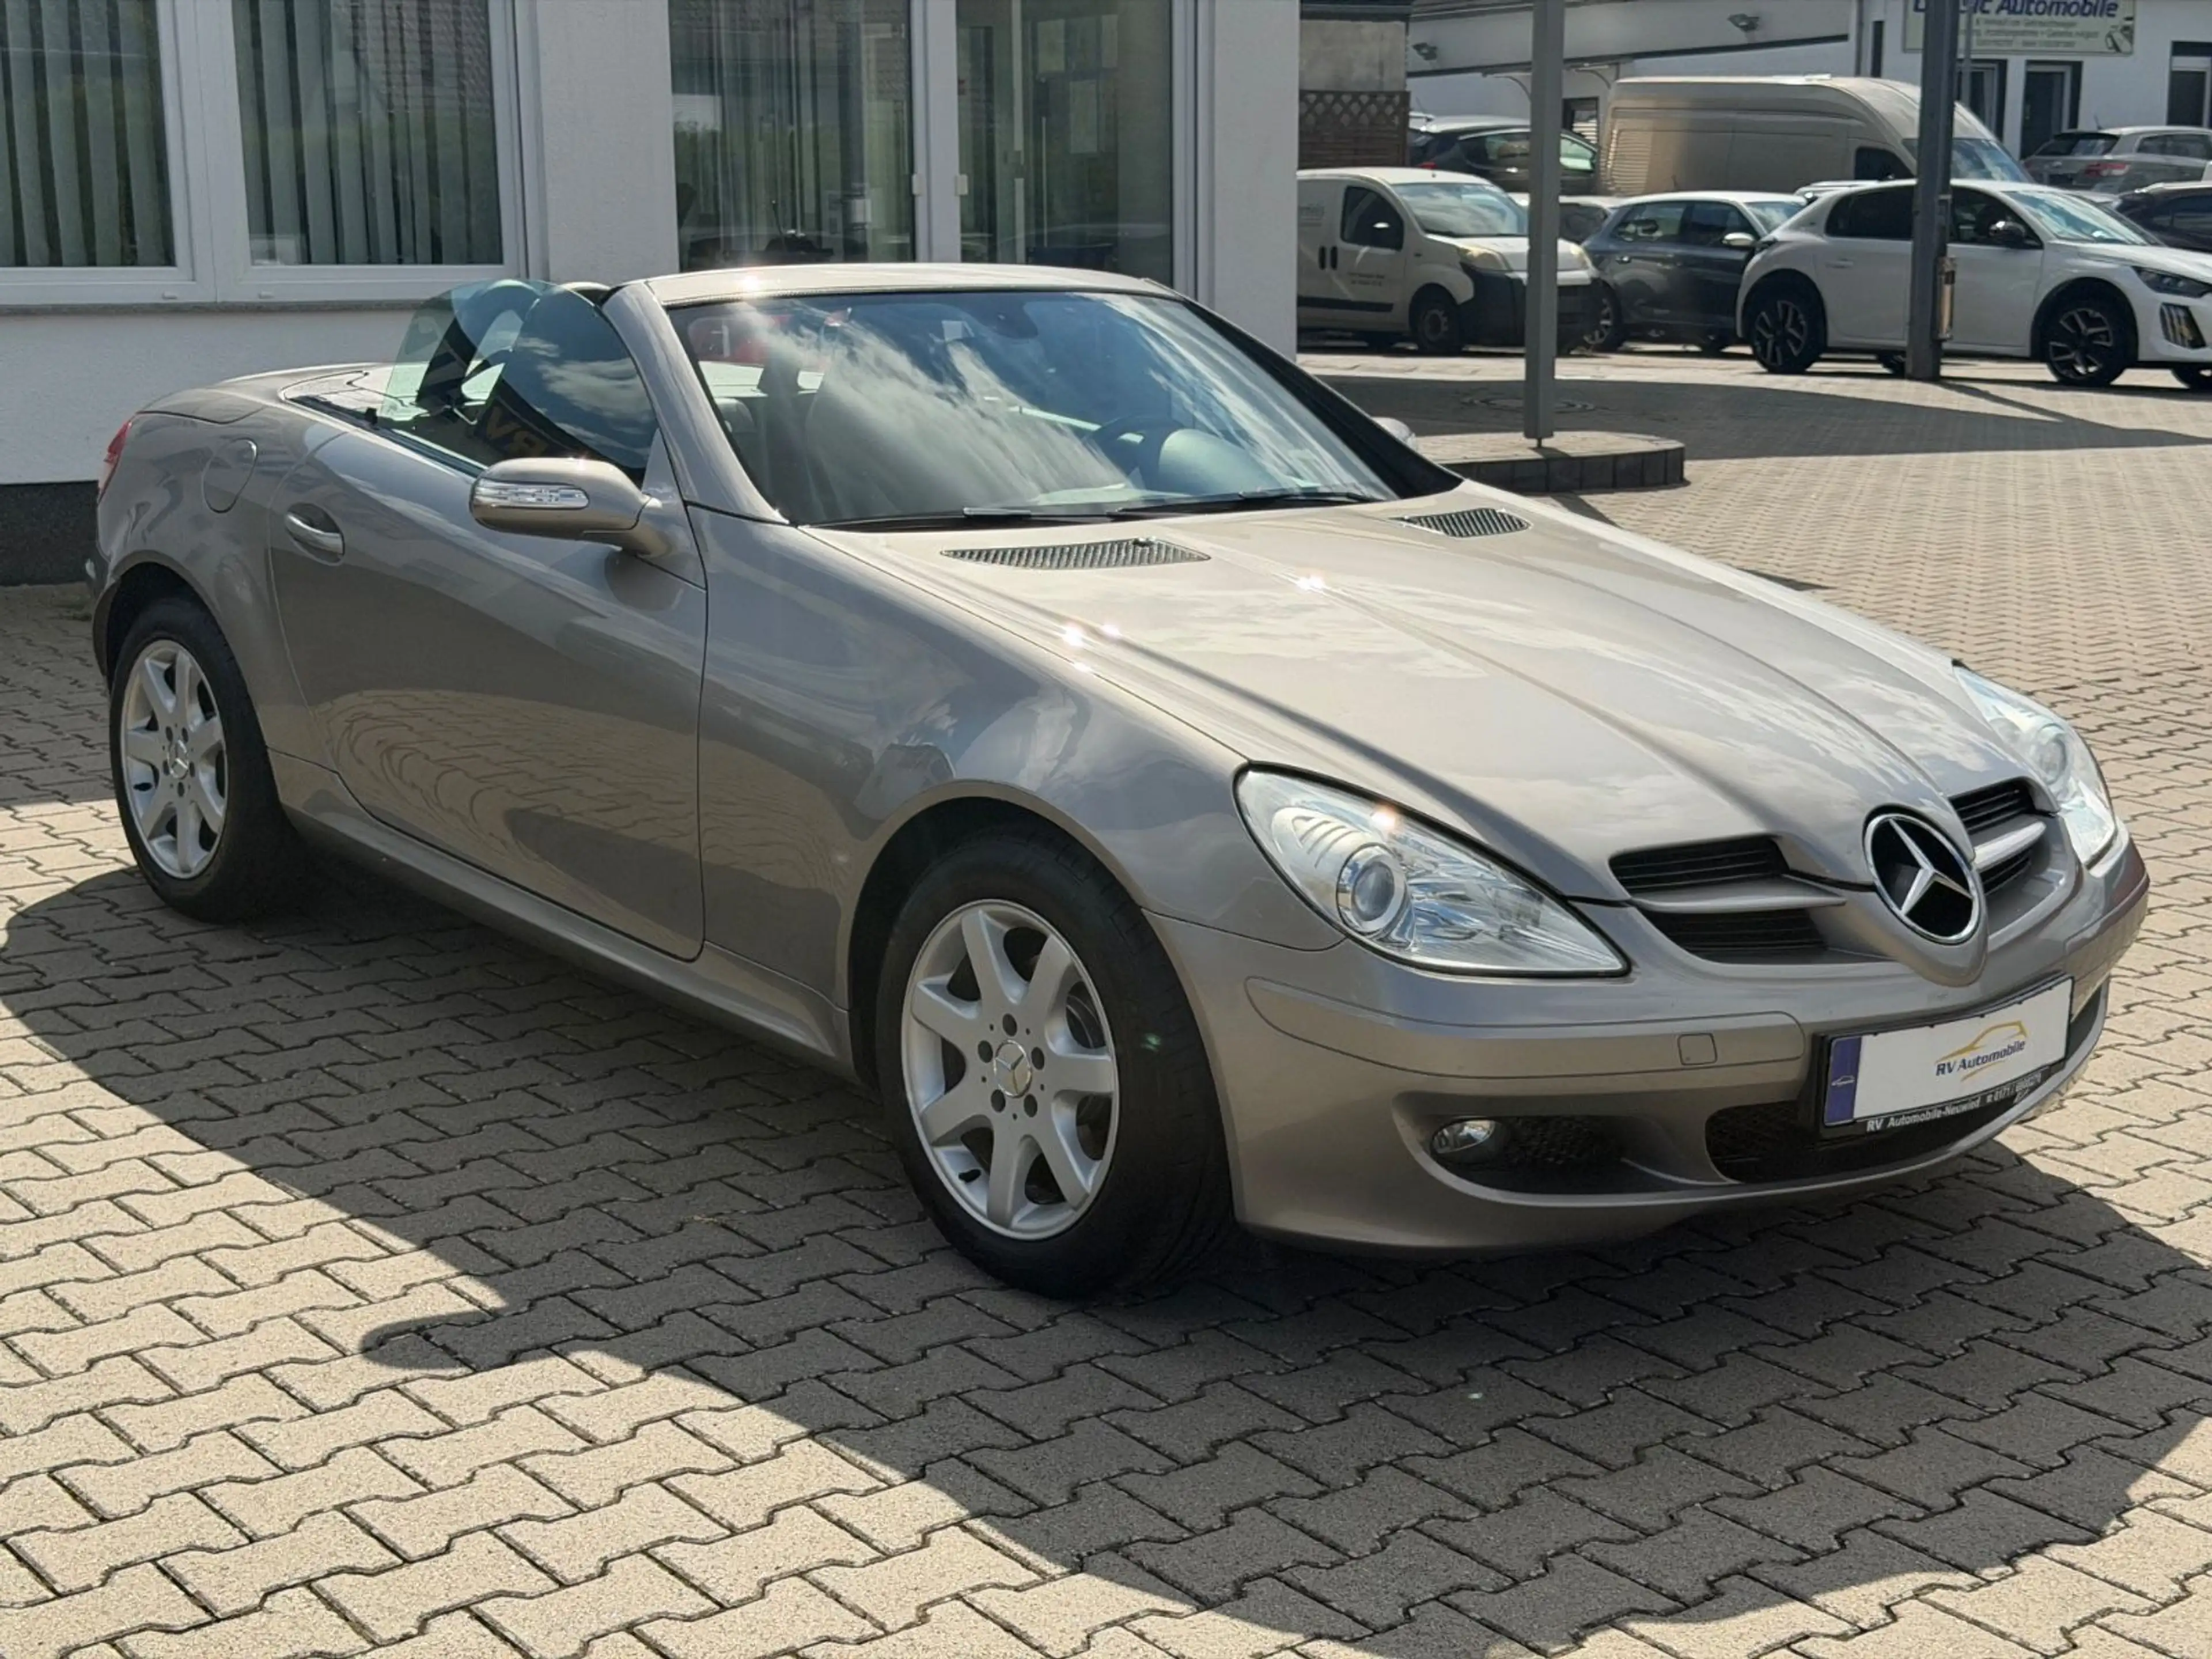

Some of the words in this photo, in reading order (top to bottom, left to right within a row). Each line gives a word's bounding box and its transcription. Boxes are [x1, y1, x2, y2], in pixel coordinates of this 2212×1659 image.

[1995, 0, 2119, 17] Automobile
[1936, 1061, 1956, 1077] RV
[1957, 1040, 2026, 1072] Automobile
[1866, 1118, 1884, 1132] RV
